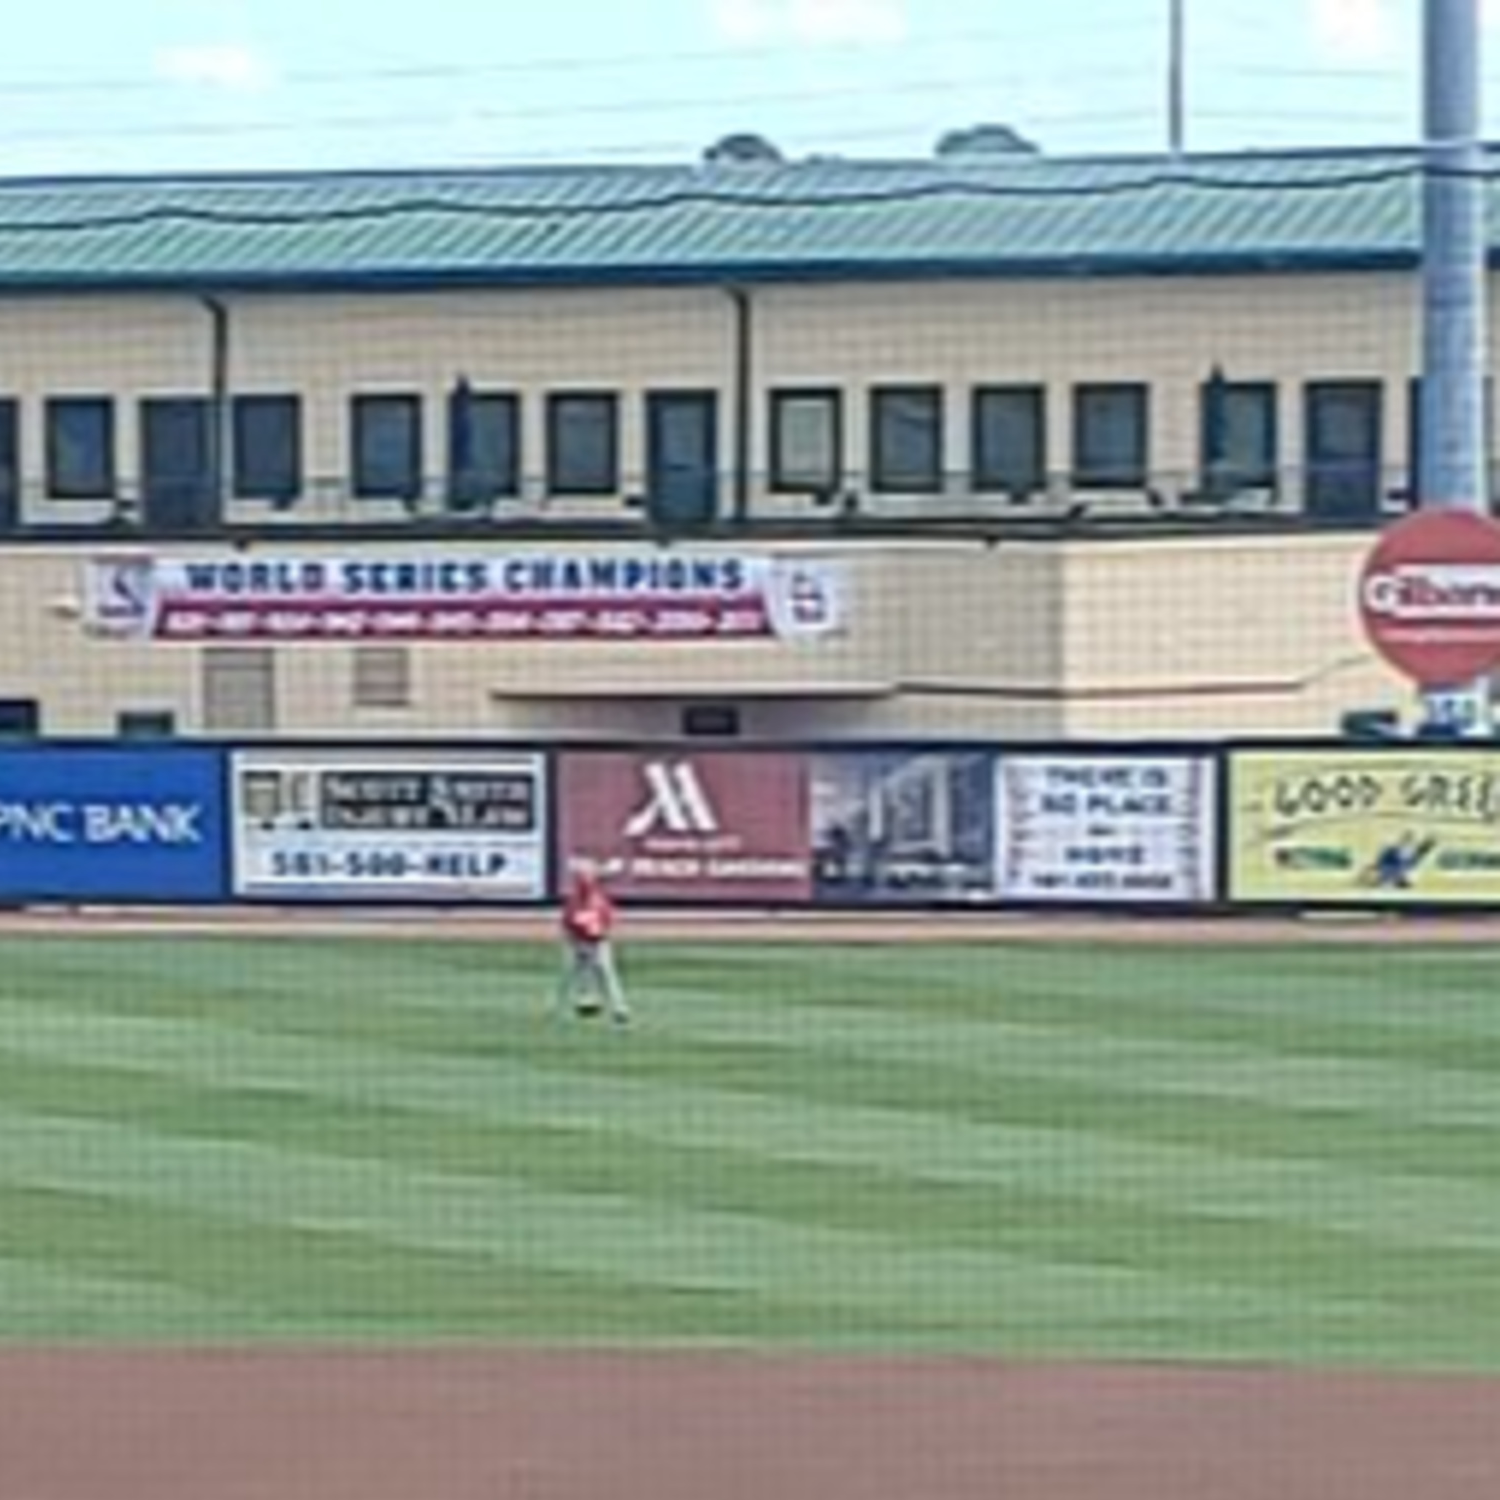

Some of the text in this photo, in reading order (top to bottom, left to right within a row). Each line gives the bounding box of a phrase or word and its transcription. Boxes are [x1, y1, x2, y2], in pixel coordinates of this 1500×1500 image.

[184, 559, 745, 594] WORLD SERIES CHAMPIONS
[1276, 774, 1382, 816] GOOD
[84, 803, 203, 844] BANK
